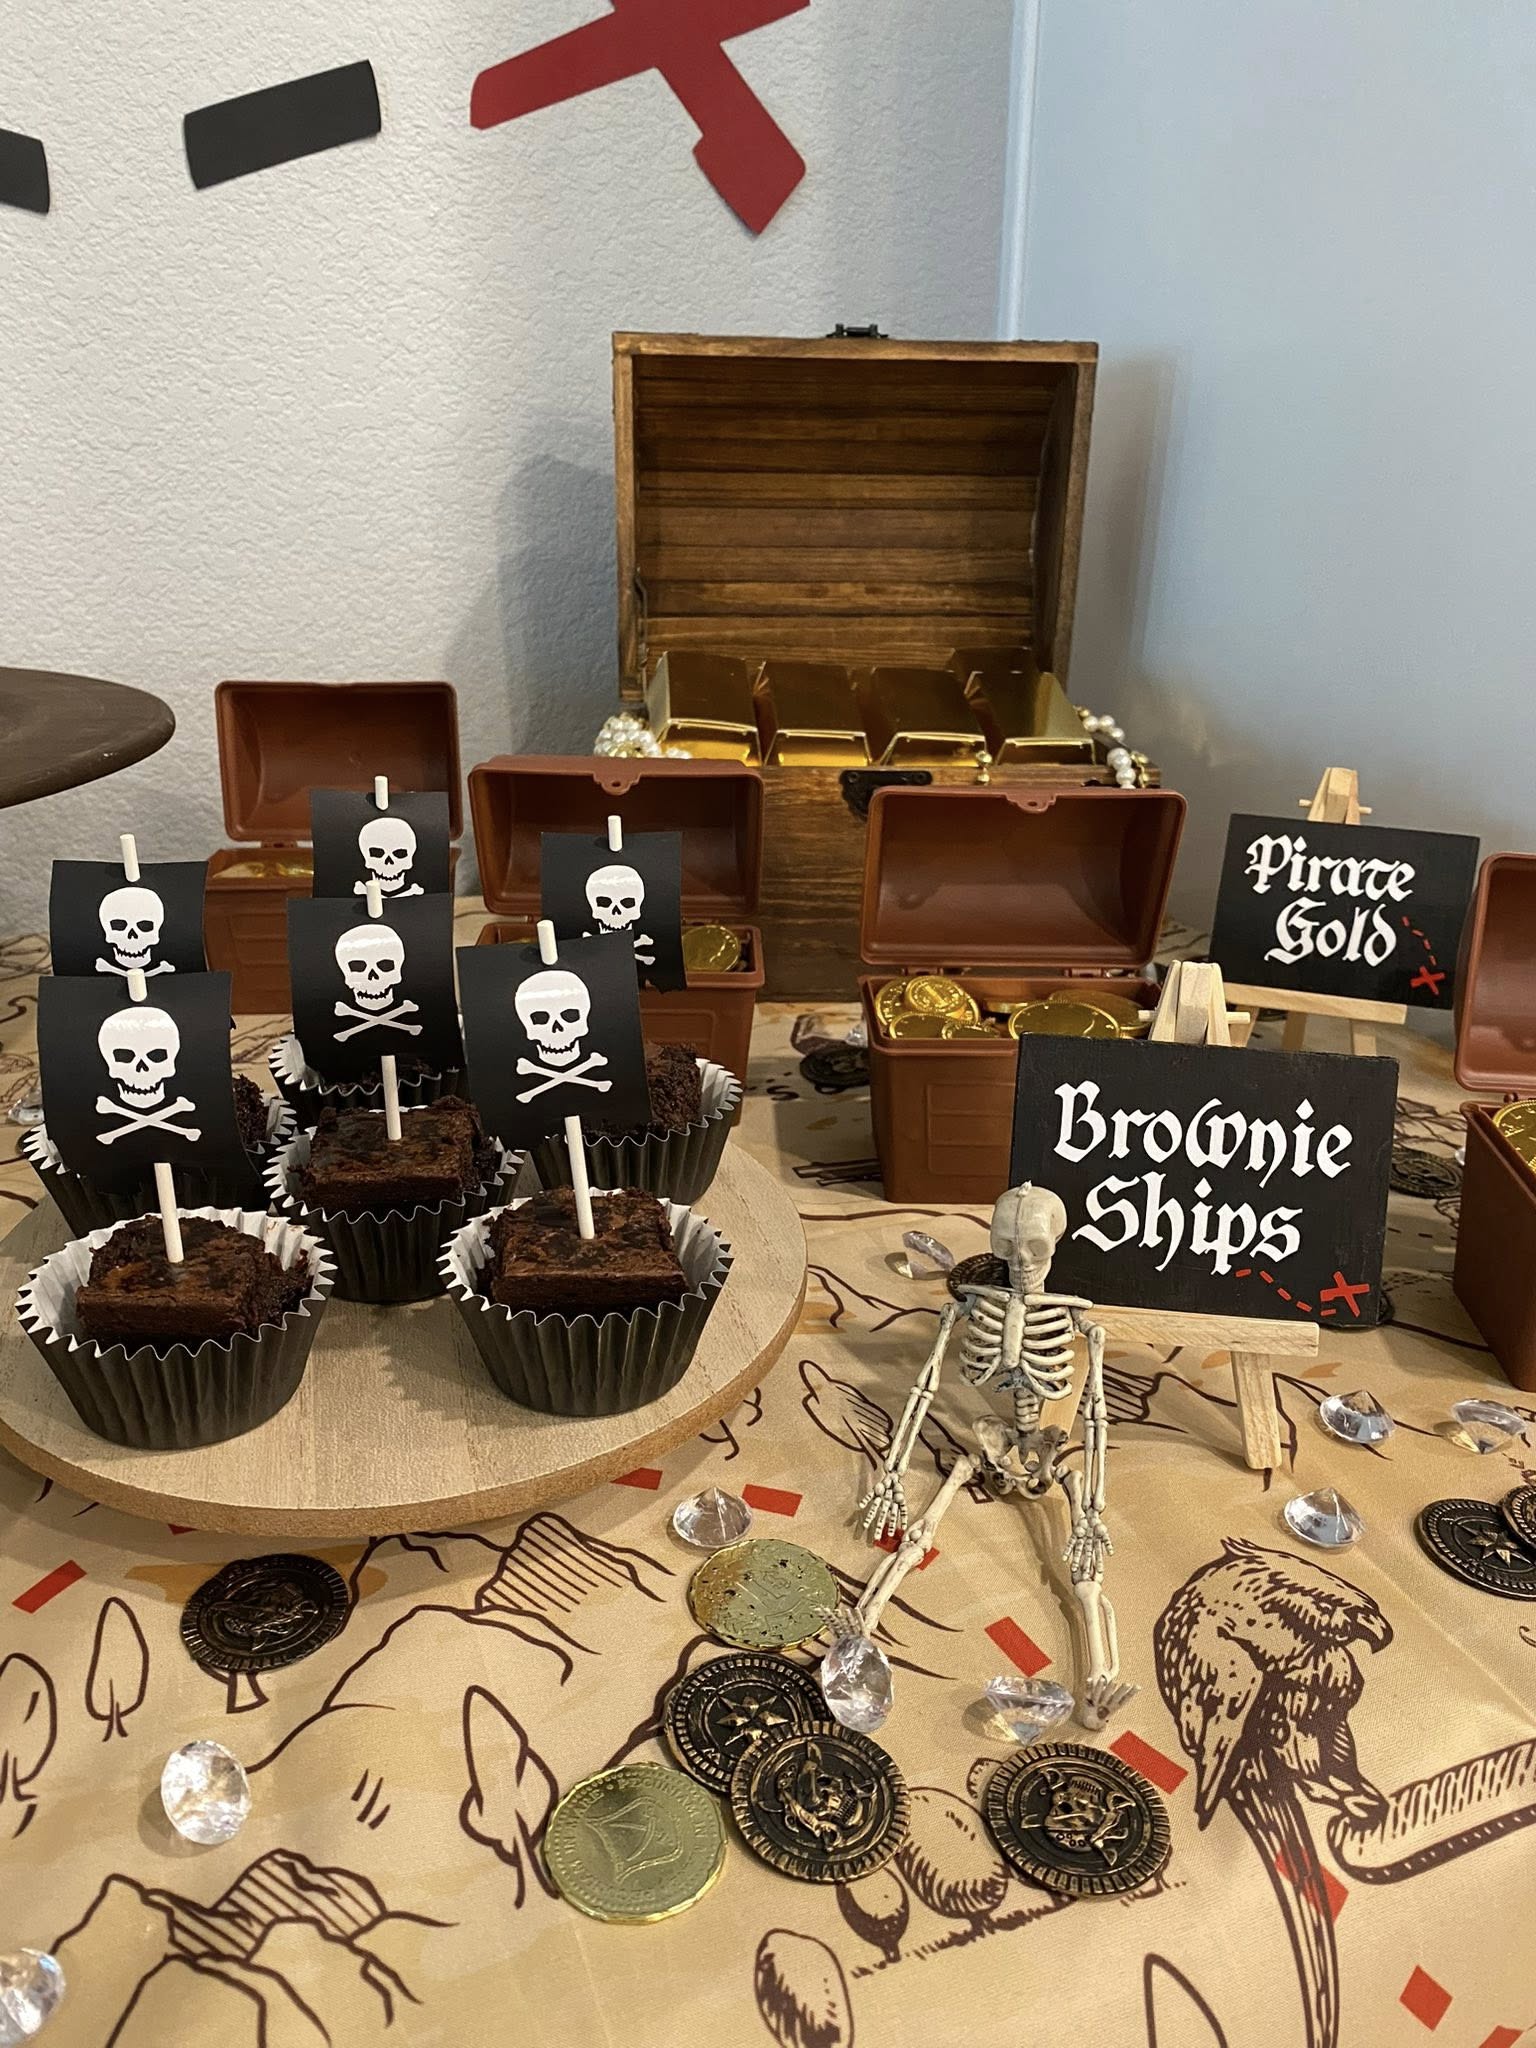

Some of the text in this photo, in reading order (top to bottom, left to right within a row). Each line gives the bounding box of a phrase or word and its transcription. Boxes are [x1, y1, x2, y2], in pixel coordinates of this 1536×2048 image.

[1244, 834, 1416, 902] Pirate
[1263, 896, 1397, 967] Gold
[1052, 1080, 1353, 1188] Brownie
[1071, 1170, 1303, 1276] Ships
